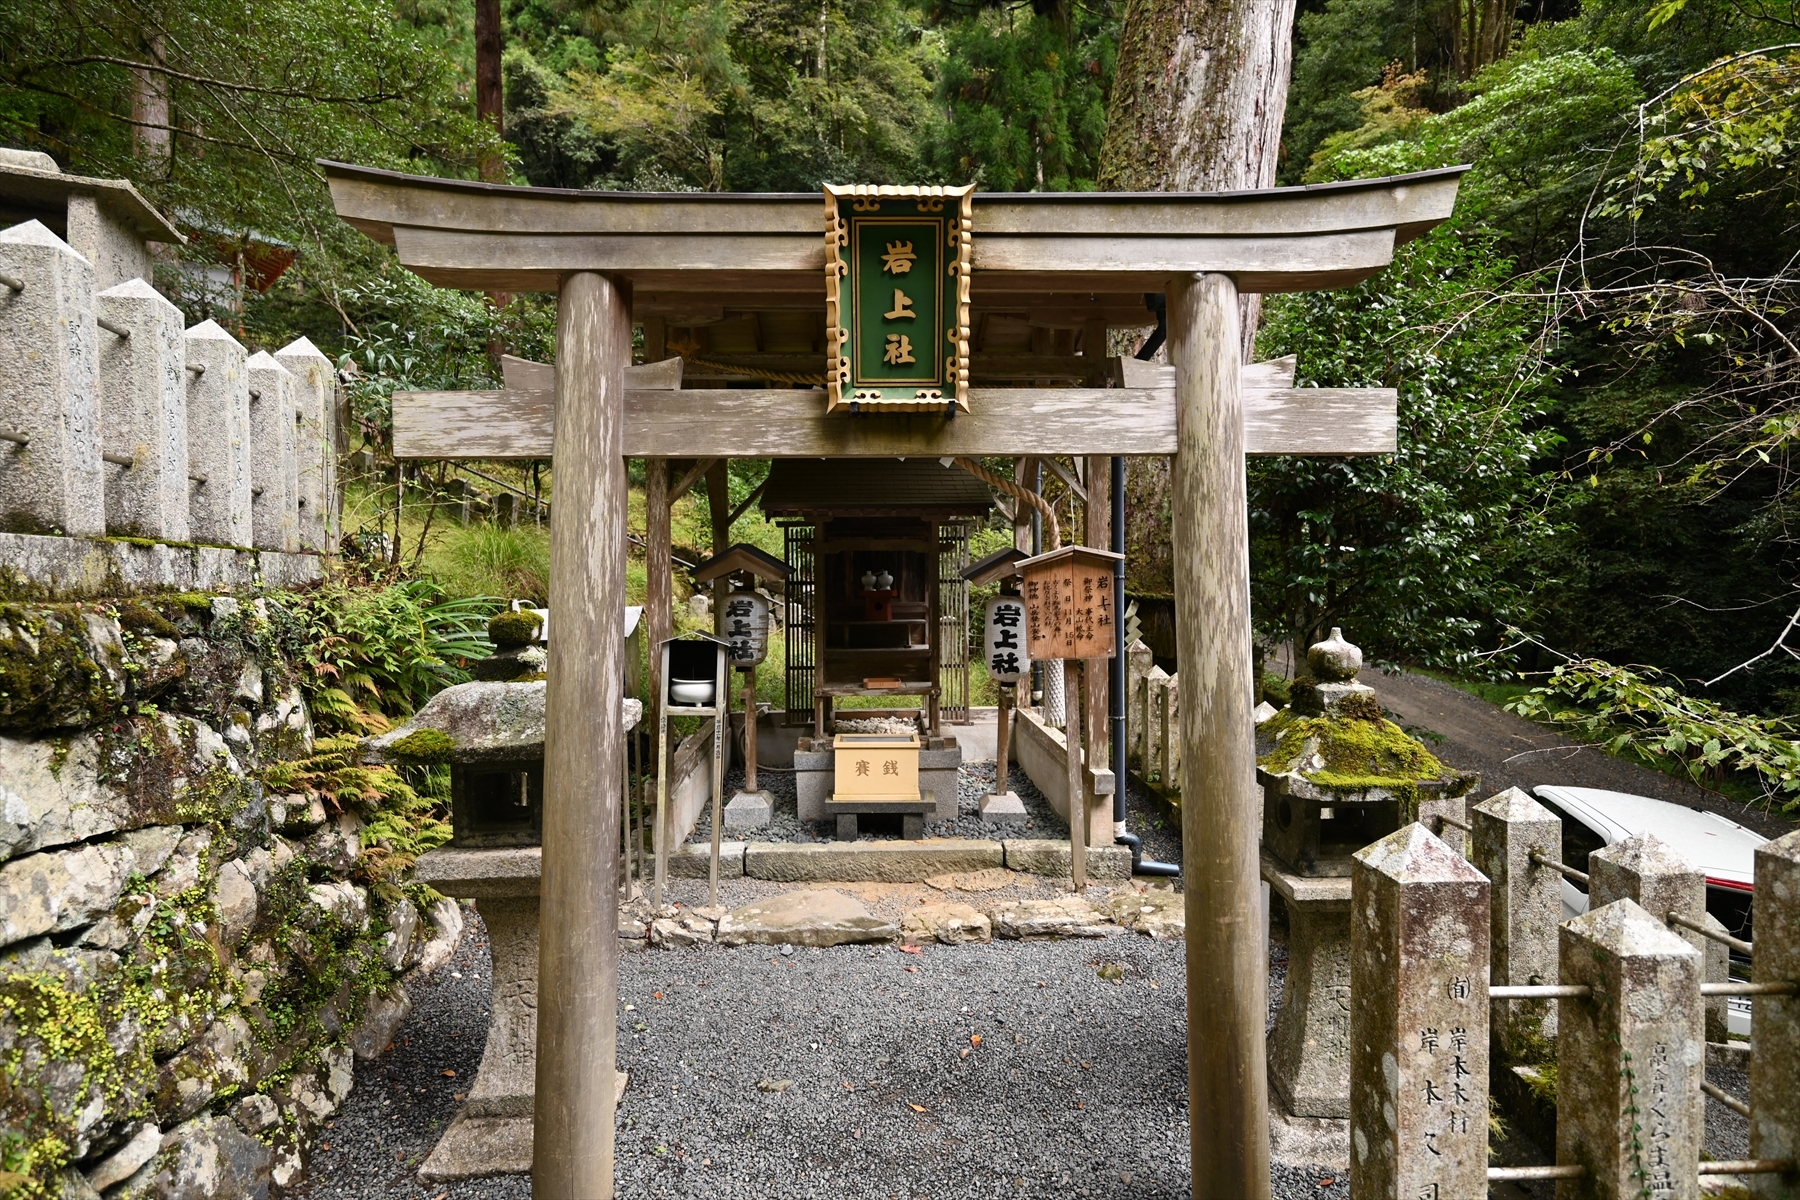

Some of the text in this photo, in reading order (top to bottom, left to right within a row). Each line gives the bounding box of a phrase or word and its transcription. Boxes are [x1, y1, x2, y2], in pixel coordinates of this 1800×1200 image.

[881, 240, 917, 365] 岩上社
[726, 600, 754, 660] 岩上社
[1096, 576, 1112, 627] 岩上社
[992, 604, 1021, 674] 岩上社
[1646, 1041, 1675, 1200] 有限会社くらま温
